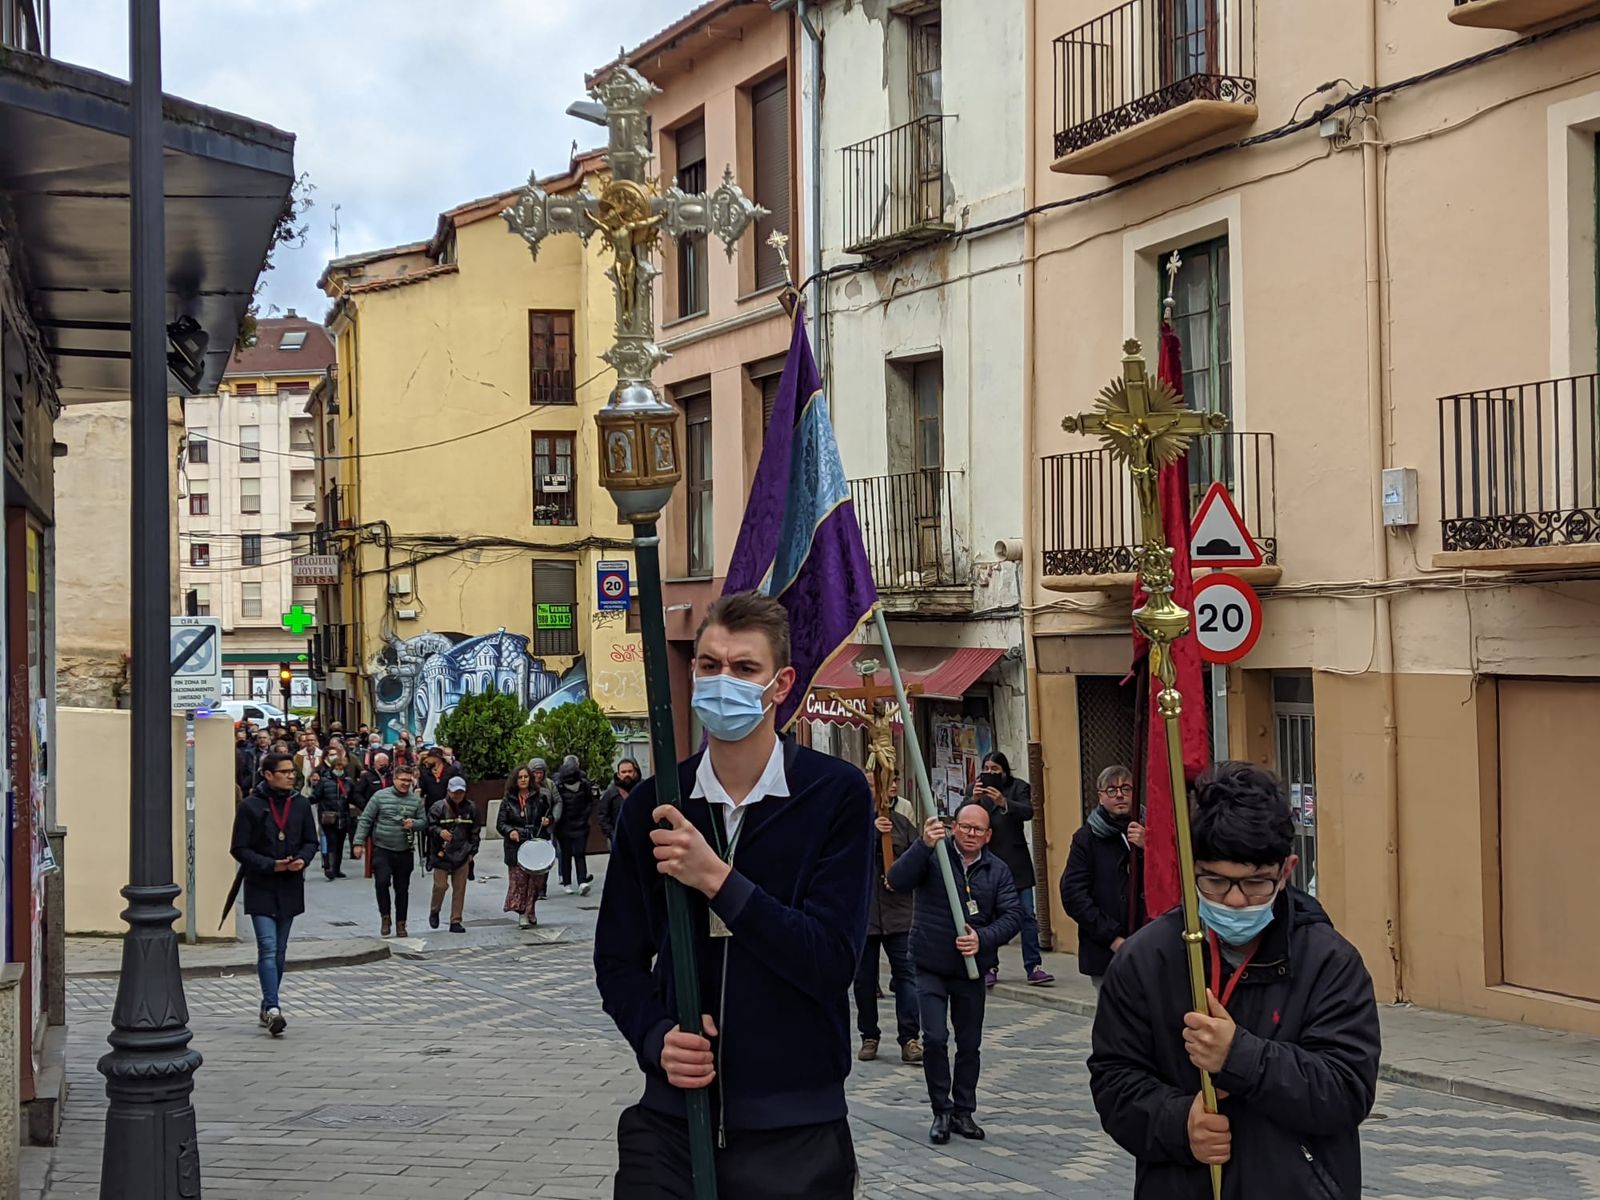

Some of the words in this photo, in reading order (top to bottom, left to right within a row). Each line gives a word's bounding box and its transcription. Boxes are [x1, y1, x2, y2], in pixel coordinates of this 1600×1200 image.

[293, 557, 337, 566] RELOJERIA
[297, 567, 333, 575] JOYERIA
[295, 576, 336, 584] ELISA
[605, 581, 622, 591] 20
[1198, 603, 1244, 633] 20
